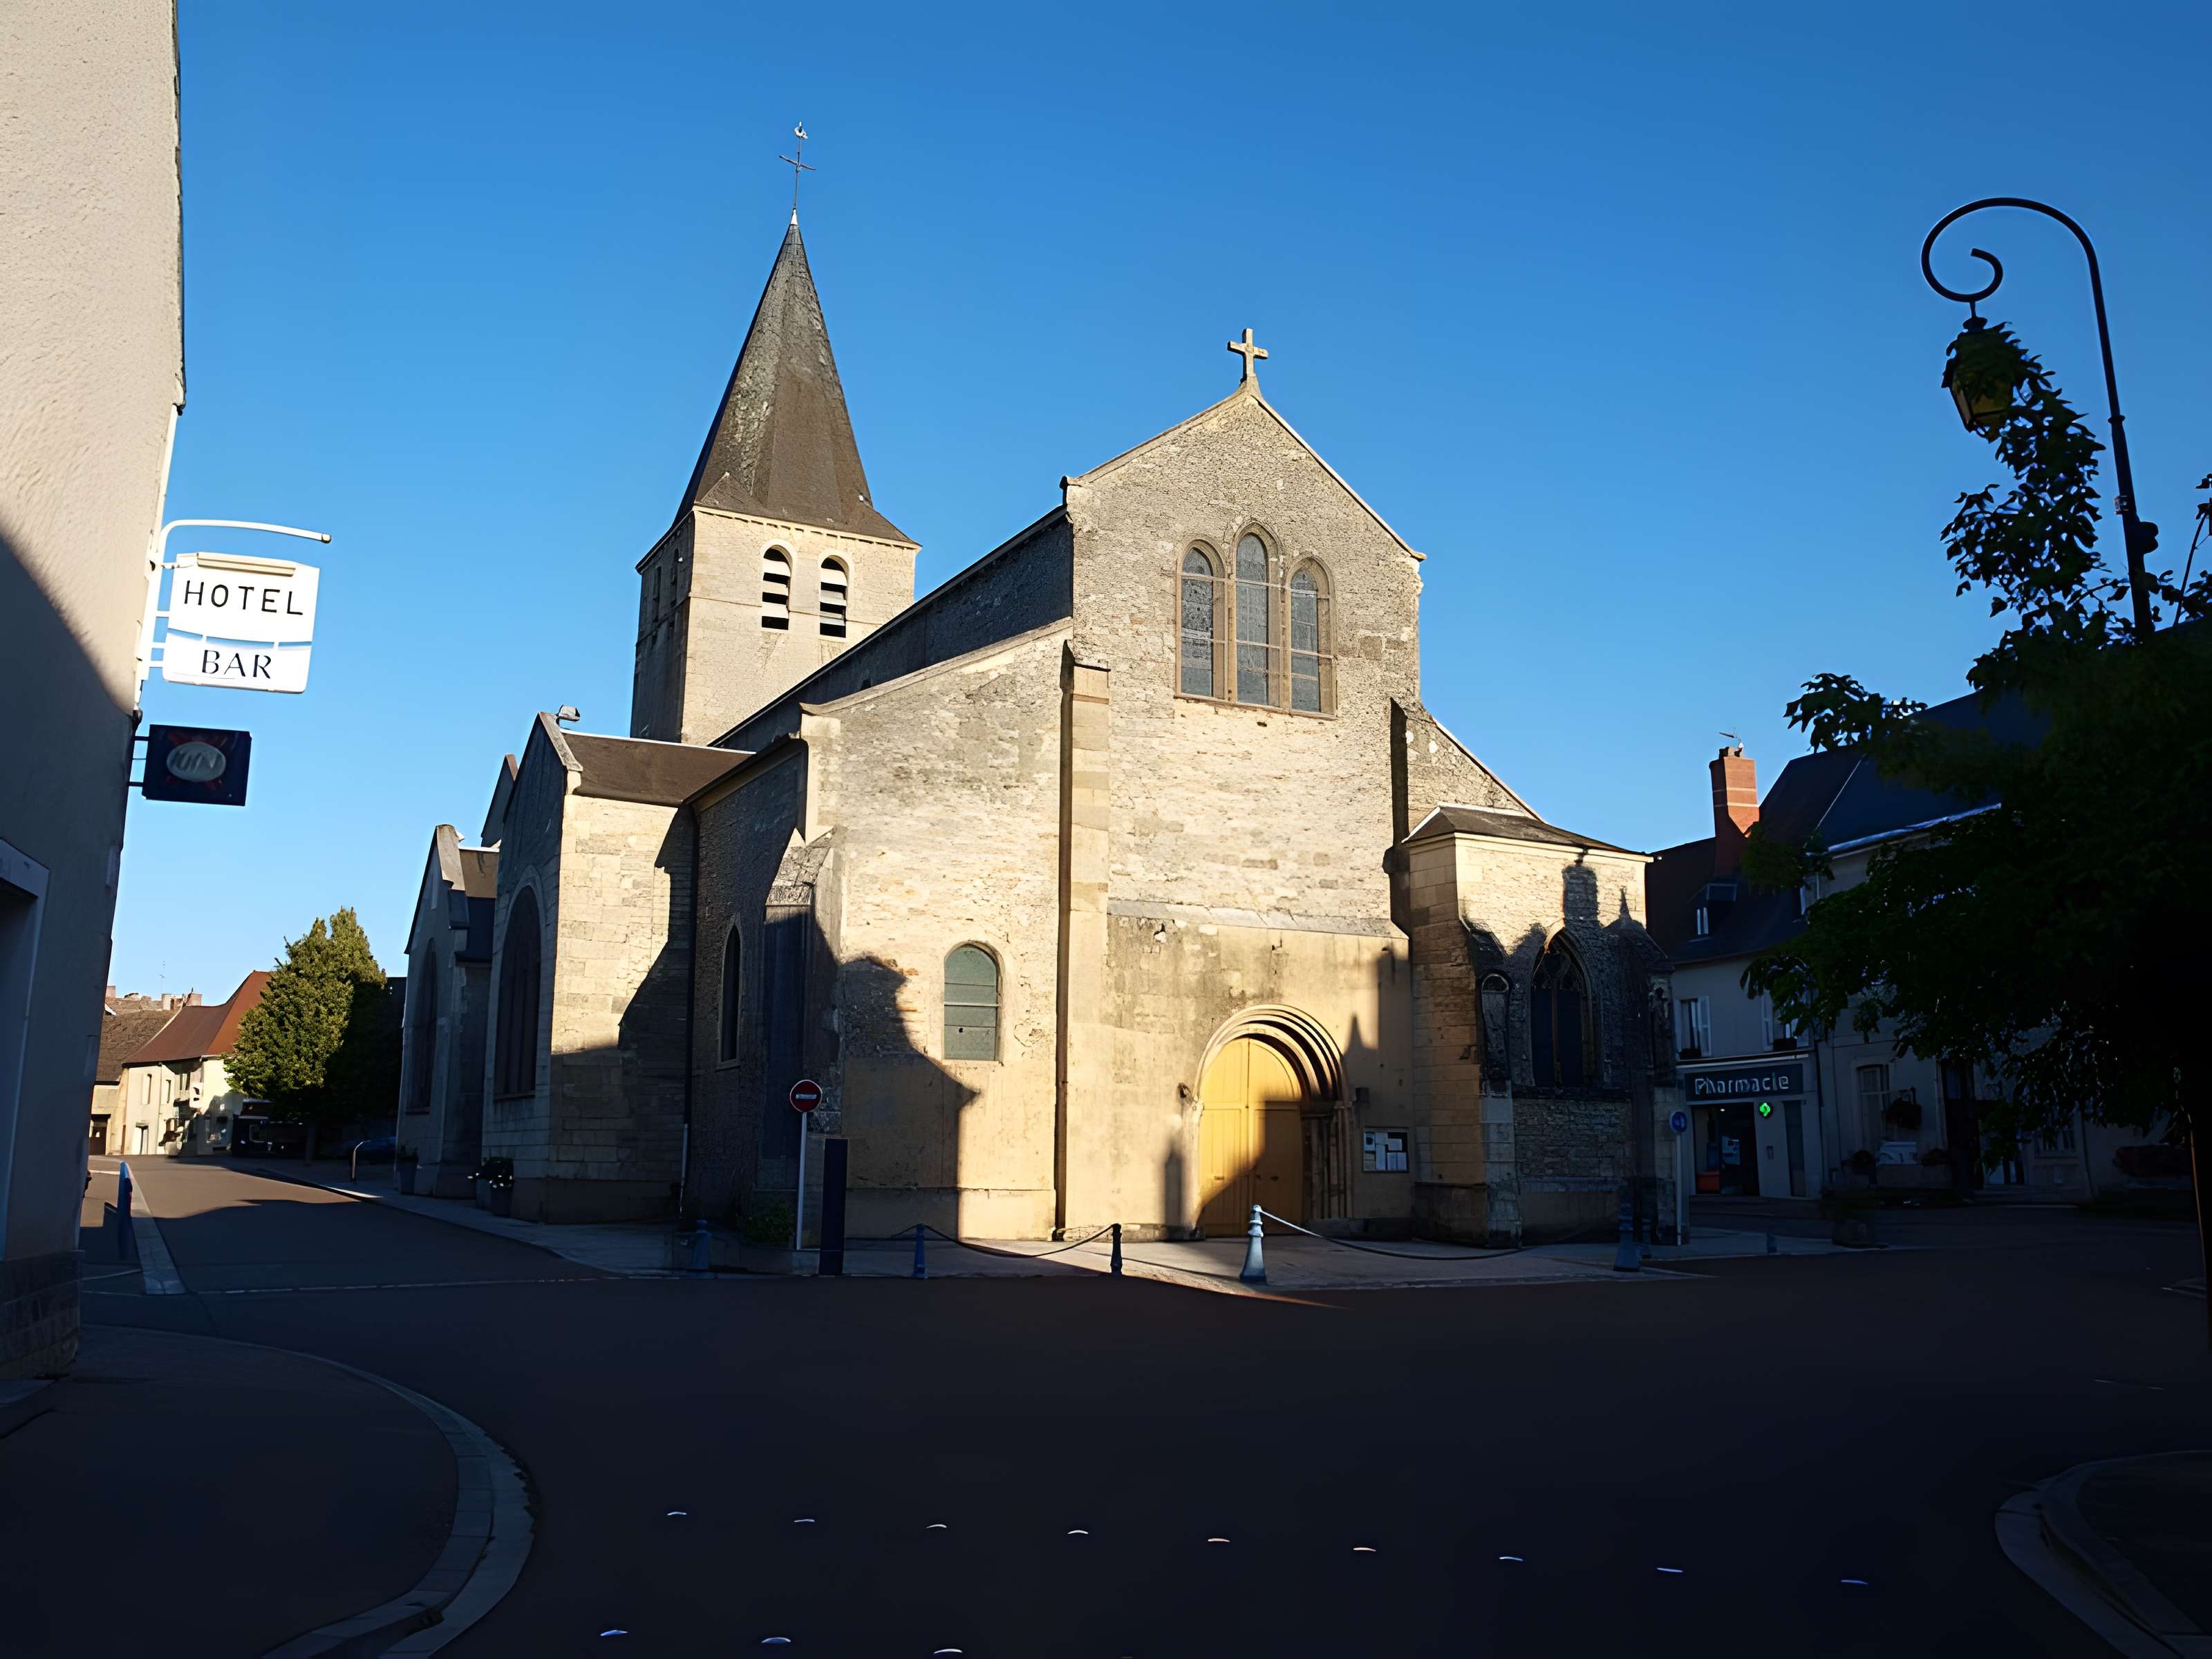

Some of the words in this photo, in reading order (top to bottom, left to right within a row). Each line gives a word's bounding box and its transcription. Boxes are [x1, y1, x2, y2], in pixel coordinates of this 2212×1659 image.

[184, 580, 303, 616] HOTEL
[202, 650, 272, 679] BAR
[1694, 1072, 1790, 1095] Pharmacie
